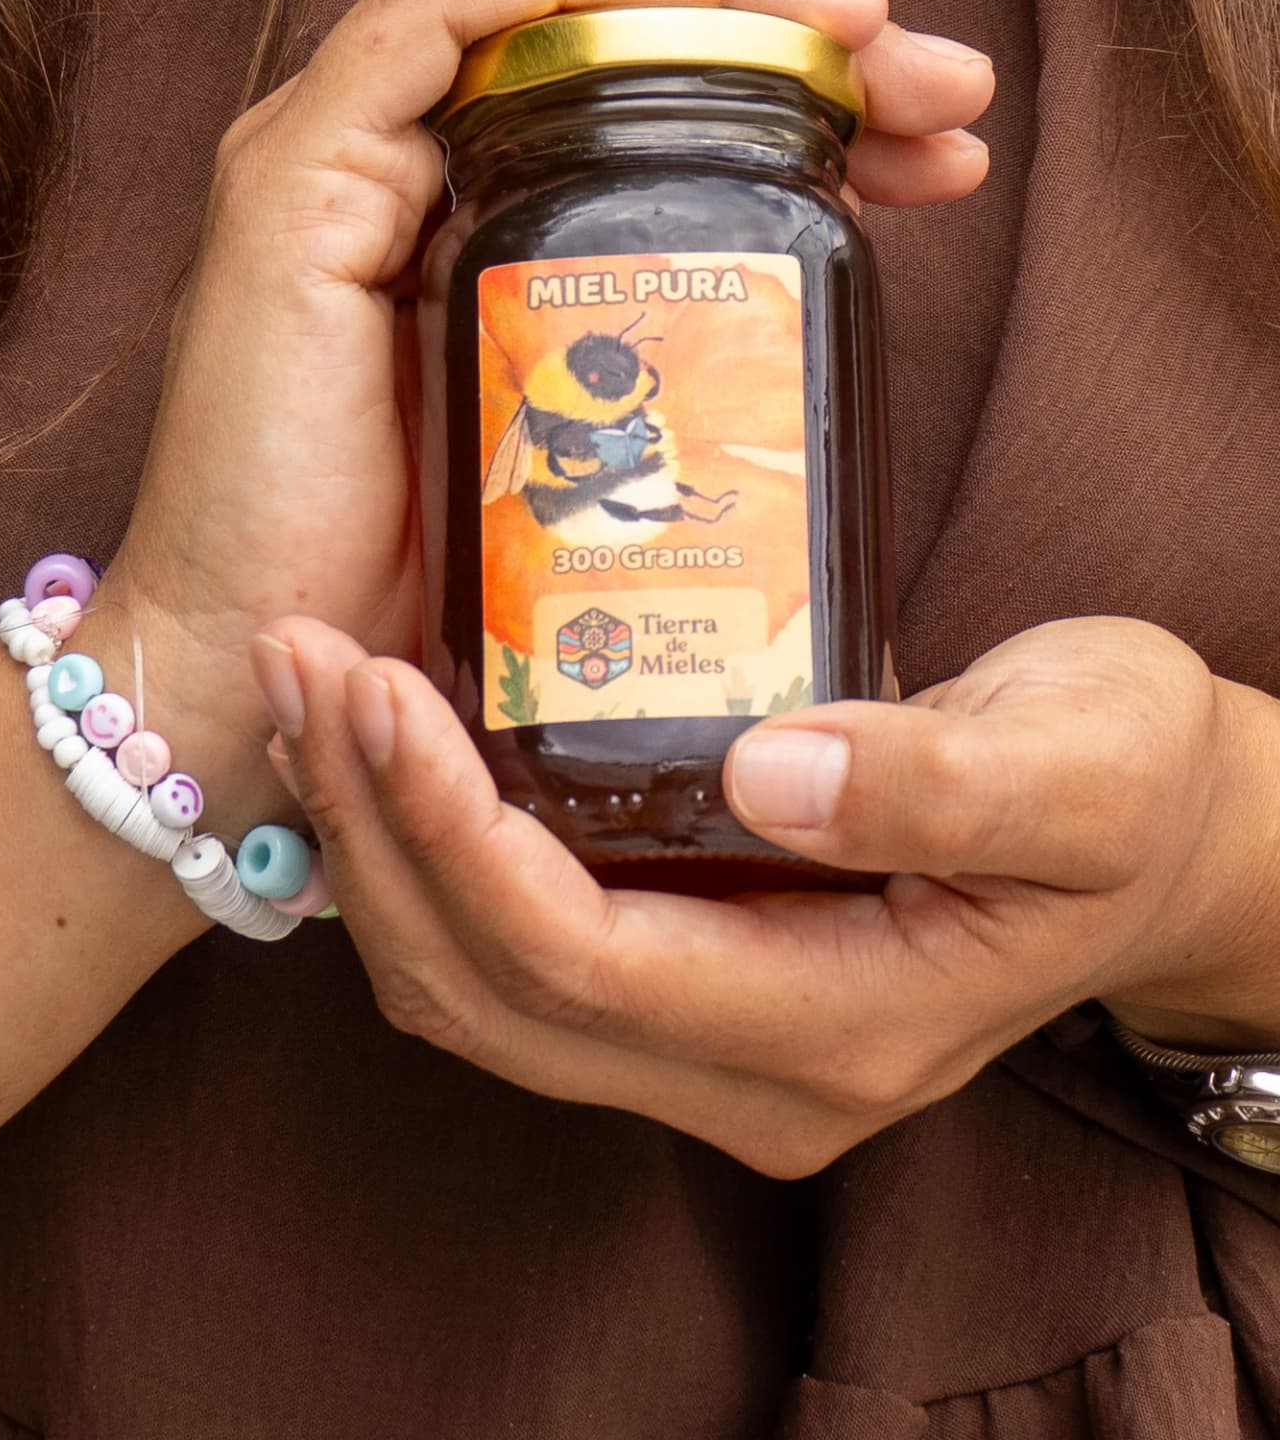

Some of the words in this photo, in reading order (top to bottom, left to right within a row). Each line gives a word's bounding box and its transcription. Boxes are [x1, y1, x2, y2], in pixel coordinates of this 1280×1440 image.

[528, 271, 627, 310] MIEL
[634, 268, 748, 303] PURA
[552, 546, 615, 574] 300
[620, 544, 744, 570] Gramos
[638, 614, 718, 635] Tierra
[665, 637, 688, 653] de
[639, 654, 726, 676] Mieles
